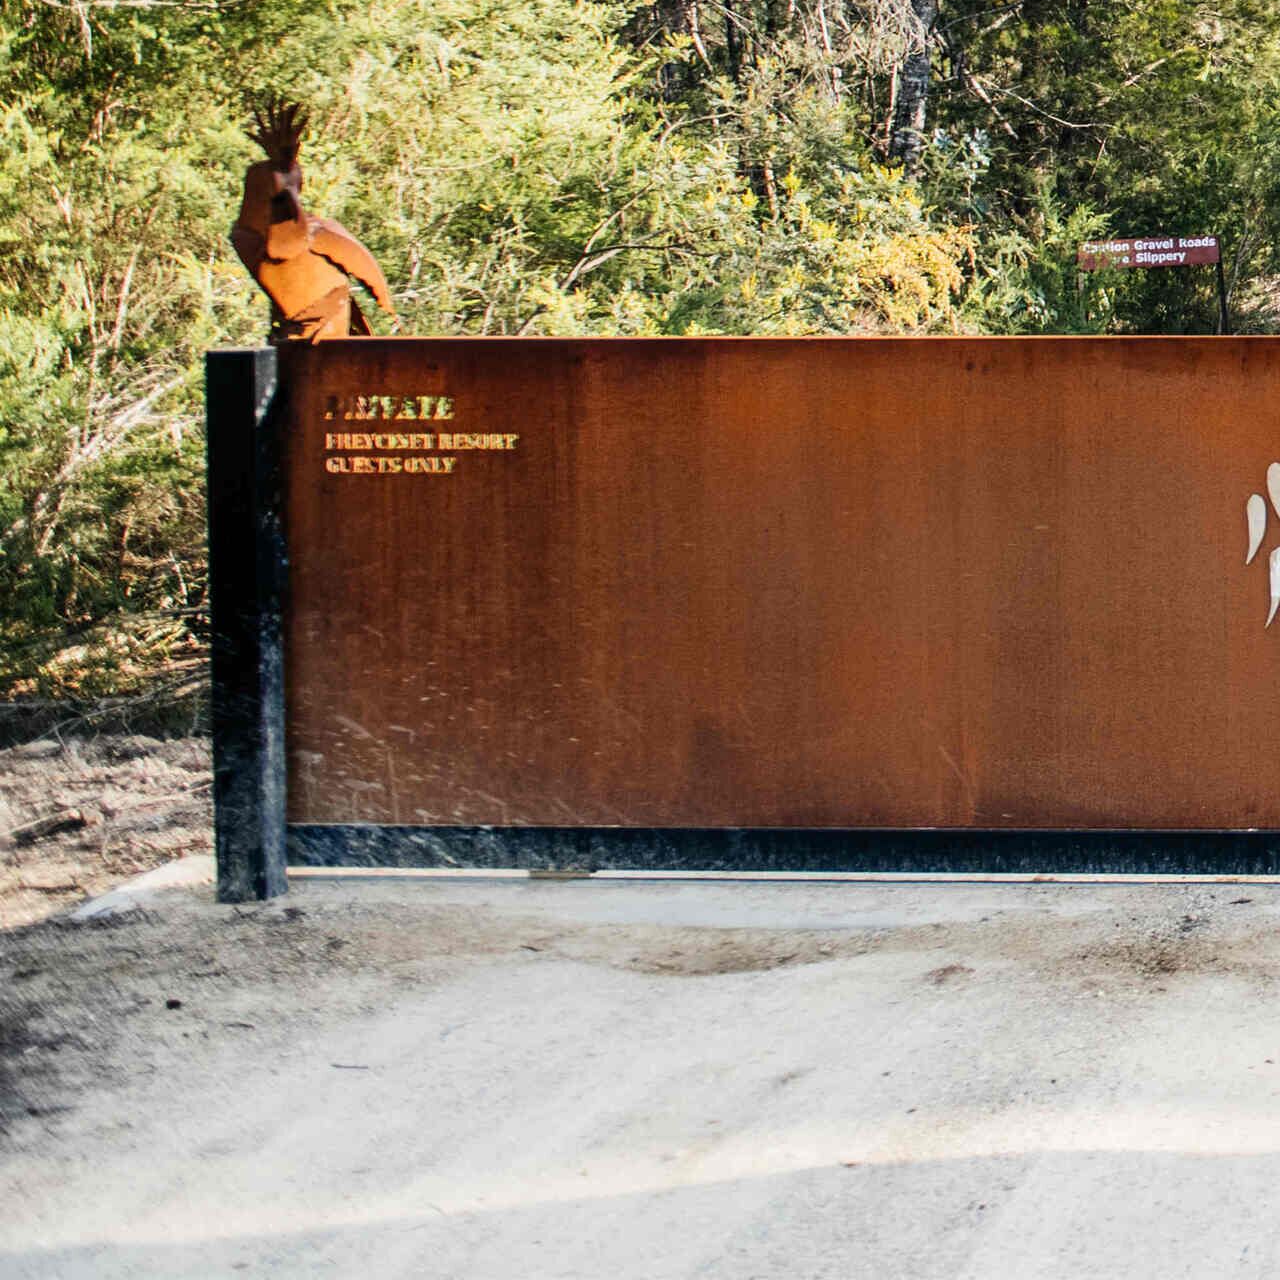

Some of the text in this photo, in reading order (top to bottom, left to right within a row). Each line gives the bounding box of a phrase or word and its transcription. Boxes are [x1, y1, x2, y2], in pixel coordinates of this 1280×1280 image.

[1134, 239, 1173, 250] Gravel
[1179, 237, 1216, 247] Roads
[1136, 252, 1186, 264] Slippery
[438, 433, 519, 449] RESORT
[325, 457, 456, 473] GUESTS ONLY
